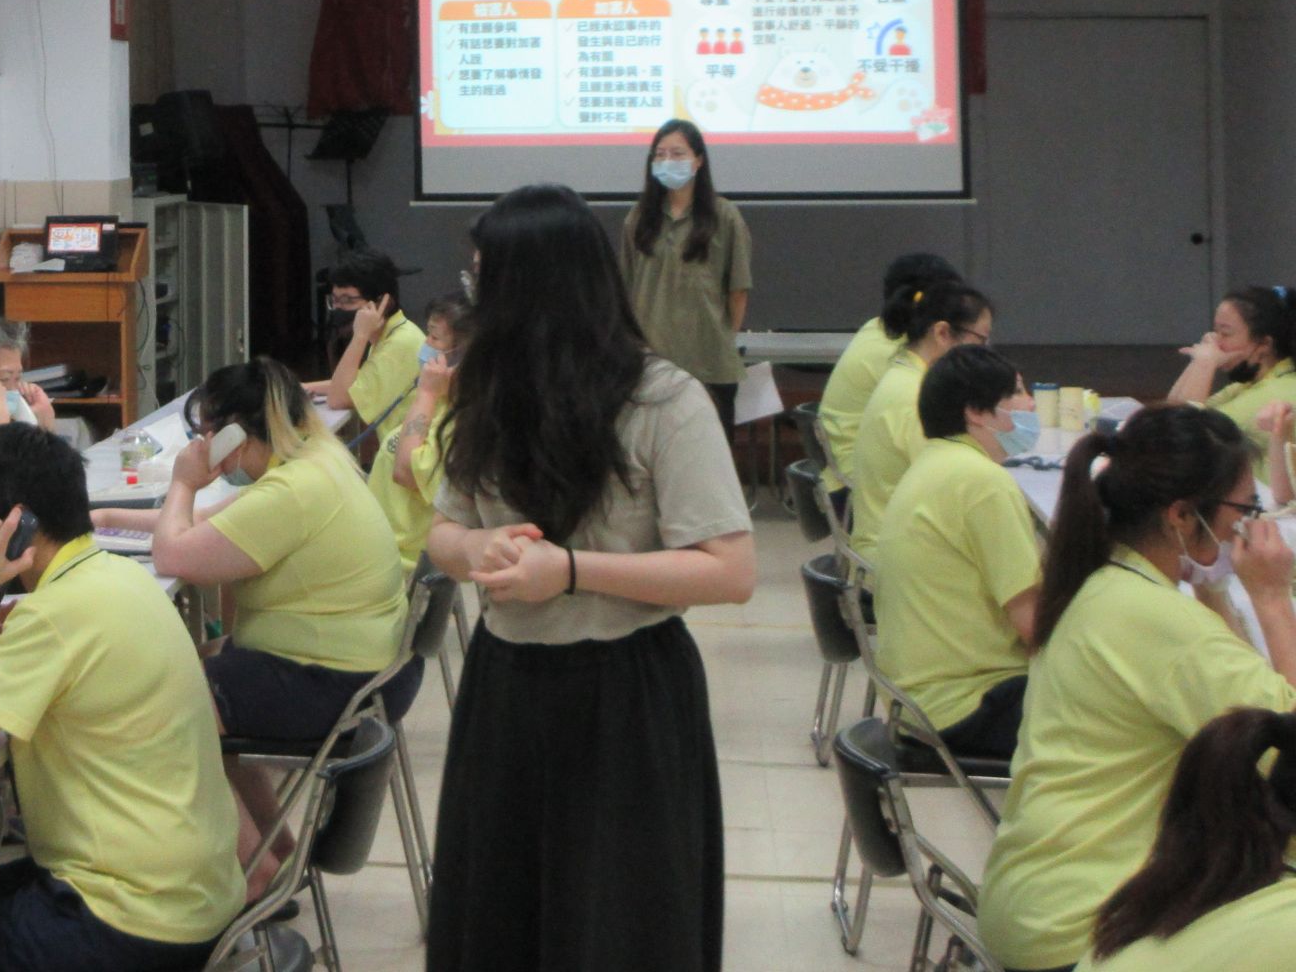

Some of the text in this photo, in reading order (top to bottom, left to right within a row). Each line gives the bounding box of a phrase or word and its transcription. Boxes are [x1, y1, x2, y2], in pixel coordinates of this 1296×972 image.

[706, 64, 736, 79] 平等
[857, 58, 921, 74] 不受干擾
